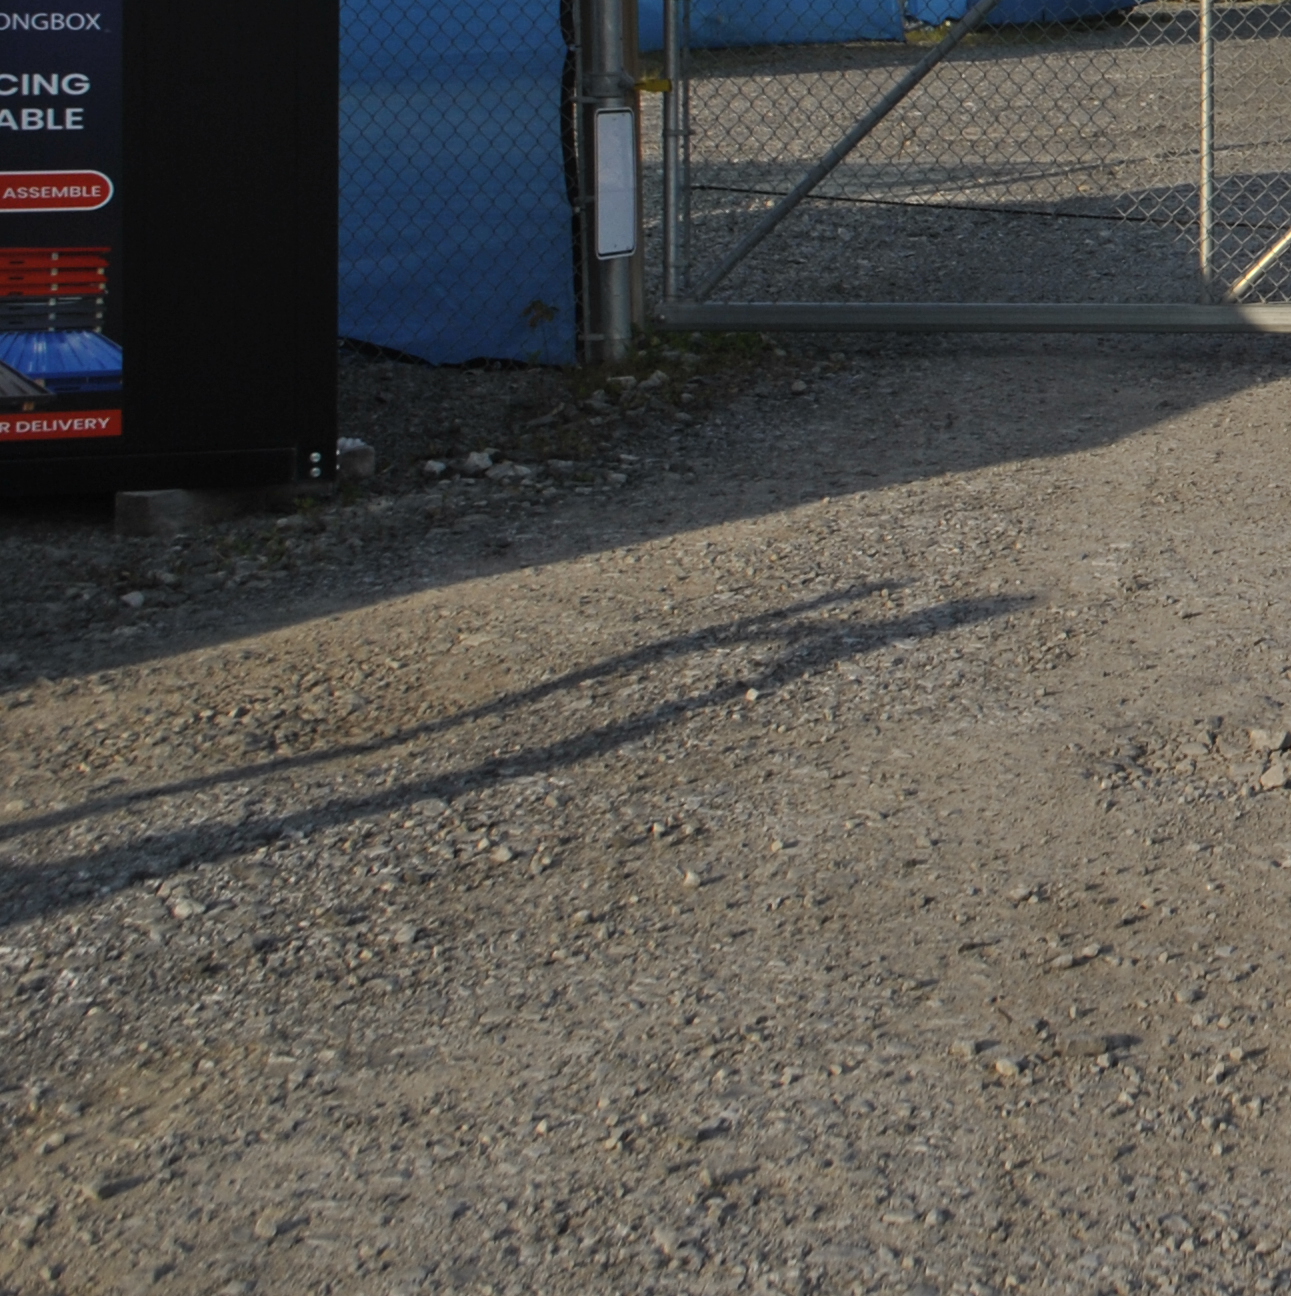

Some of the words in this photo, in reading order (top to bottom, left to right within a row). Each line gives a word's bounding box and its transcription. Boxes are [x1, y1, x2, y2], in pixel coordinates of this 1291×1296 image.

[0, 12, 101, 30] ONGBOX
[0, 73, 91, 96] CING
[0, 108, 84, 130] ABLE
[2, 185, 102, 200] ASSEMBLE
[16, 417, 110, 433] DELIVERY
